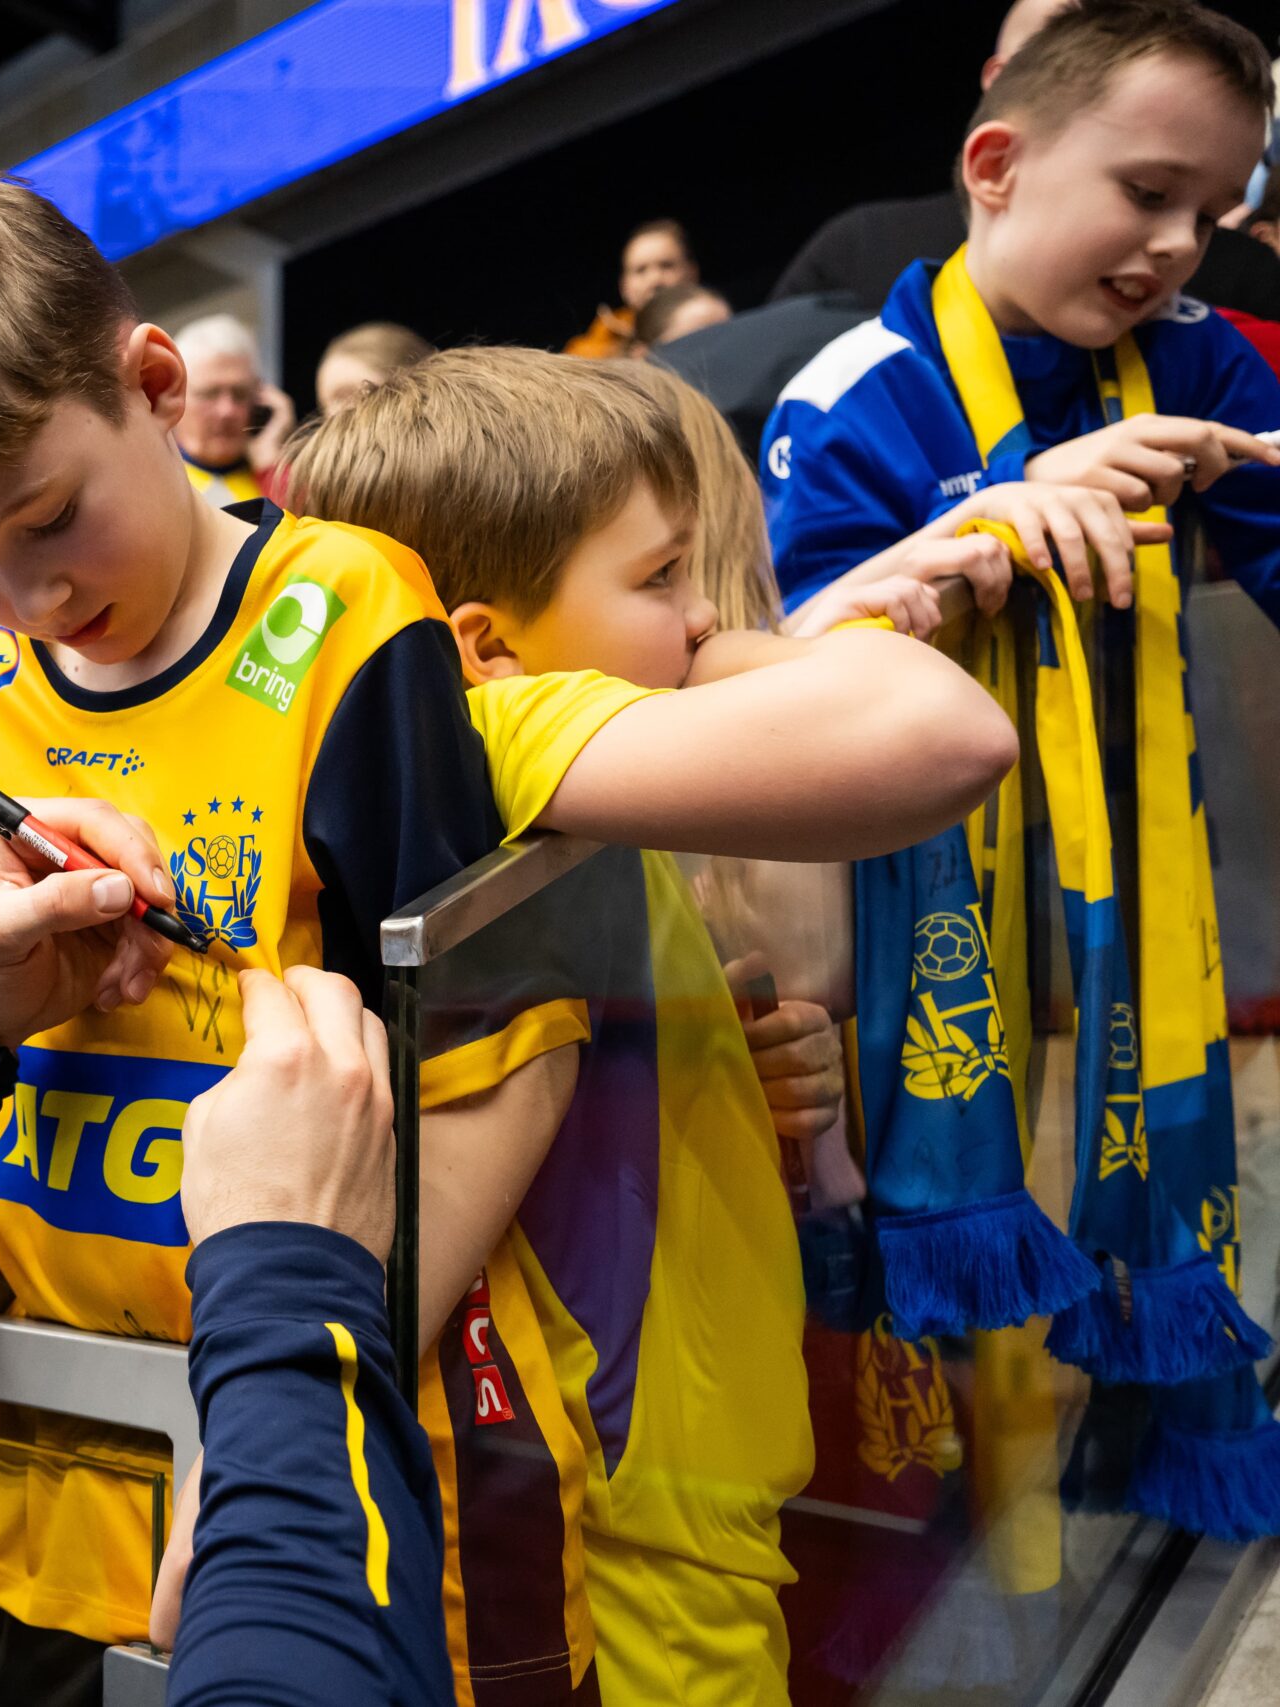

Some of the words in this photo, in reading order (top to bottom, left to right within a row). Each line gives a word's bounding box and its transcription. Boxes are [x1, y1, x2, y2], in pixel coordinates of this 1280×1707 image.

[235, 651, 295, 712] bring
[46, 747, 123, 771] CRAFT
[2, 1082, 186, 1205] ATG
